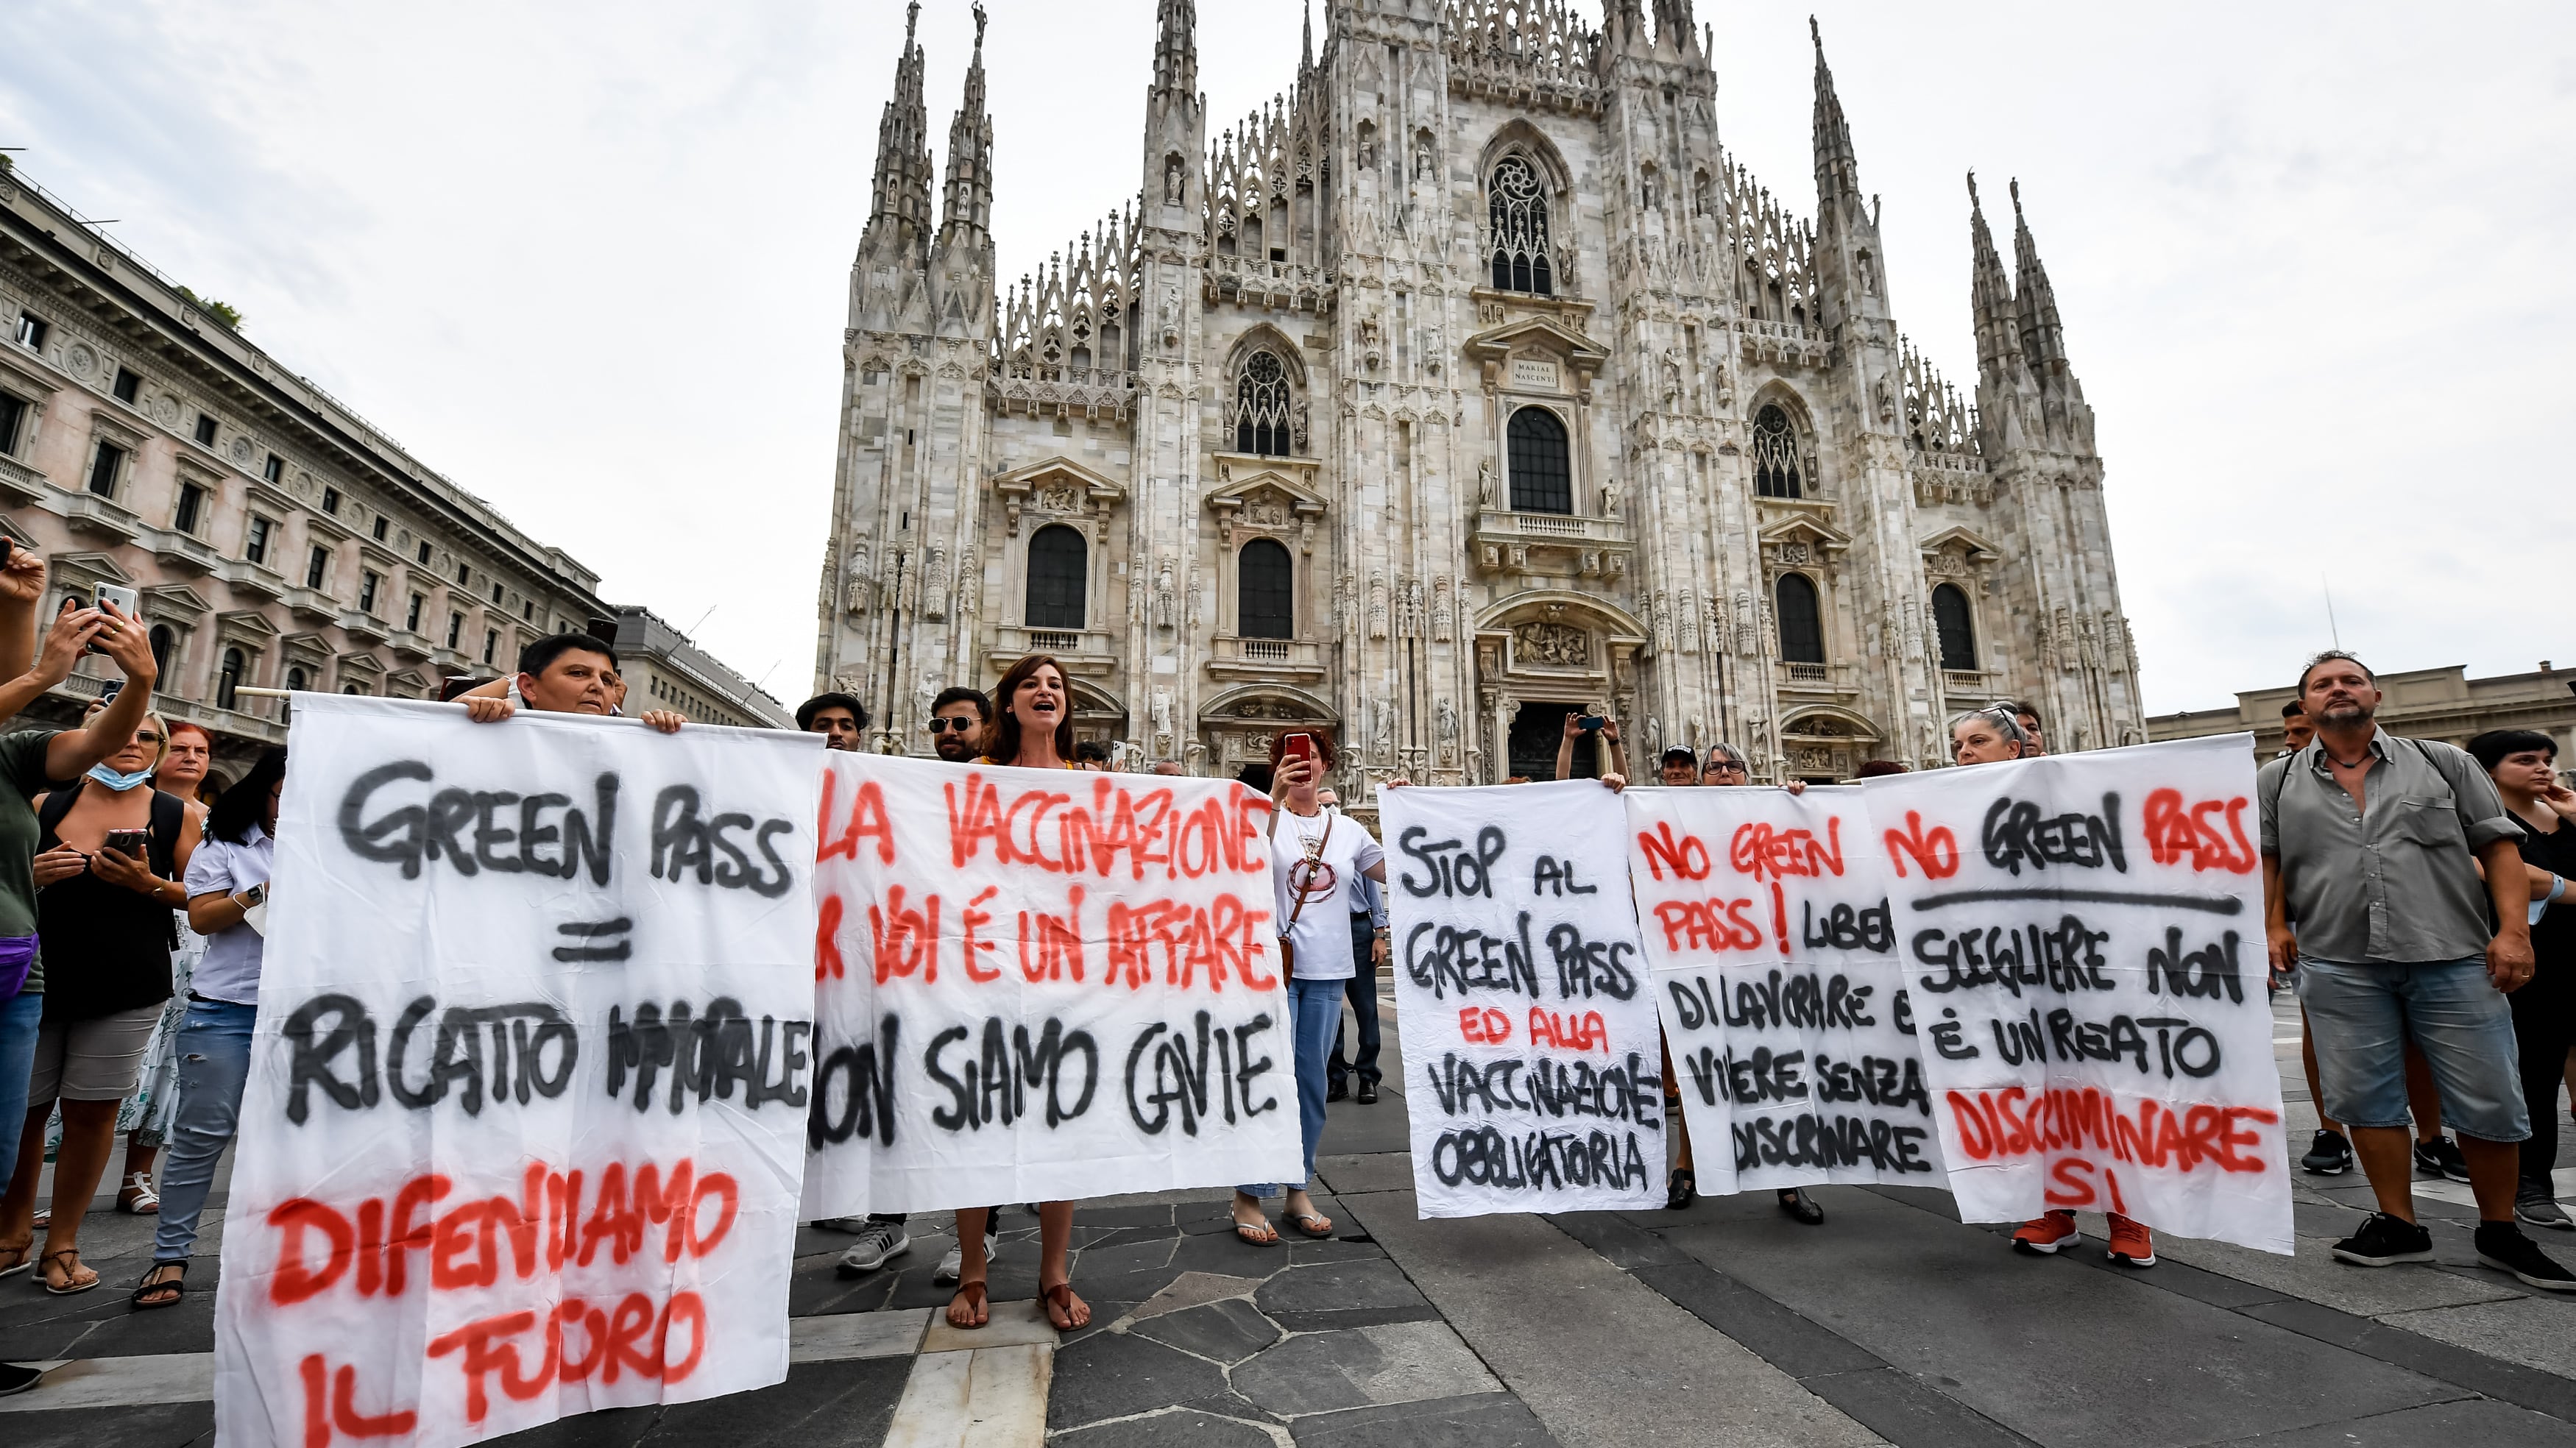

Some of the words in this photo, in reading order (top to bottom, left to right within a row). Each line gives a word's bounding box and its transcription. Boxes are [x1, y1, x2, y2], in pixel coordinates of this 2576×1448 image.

[1515, 373, 1554, 383] NASCENTI
[337, 759, 620, 887] GREEN
[651, 783, 794, 898] PASS
[815, 768, 894, 866] LA
[944, 772, 1270, 881] VACCINAZIONE
[1399, 825, 1507, 899] STOP
[1534, 854, 1596, 896] AL
[1638, 820, 1711, 881] NO
[1730, 816, 1845, 883] GREEN
[1884, 809, 1959, 880] NO
[1981, 791, 2128, 876] GREEN
[2143, 787, 2257, 874] PASS
[868, 884, 940, 986] VOI
[1017, 885, 1085, 985] UN
[1104, 892, 1278, 993] AFFARE
[1406, 912, 1540, 1001] GREEN
[1546, 923, 1638, 1002] PASS
[1912, 913, 2117, 998] SCEGLIERE
[2148, 926, 2243, 1004] NON
[283, 993, 579, 1126] RICATTO
[924, 1015, 1100, 1131] SIAMO
[1459, 1006, 1512, 1046] ED
[1529, 1005, 1610, 1054] ALLA
[1992, 1007, 2046, 1067] UN
[2049, 1008, 2221, 1079] REATO
[1428, 1051, 1662, 1130] VACCINAZIONE
[1815, 1054, 1931, 1117] SENZA
[1432, 1125, 1649, 1191] OBBLIGATORIA
[299, 1352, 417, 1448] IL
